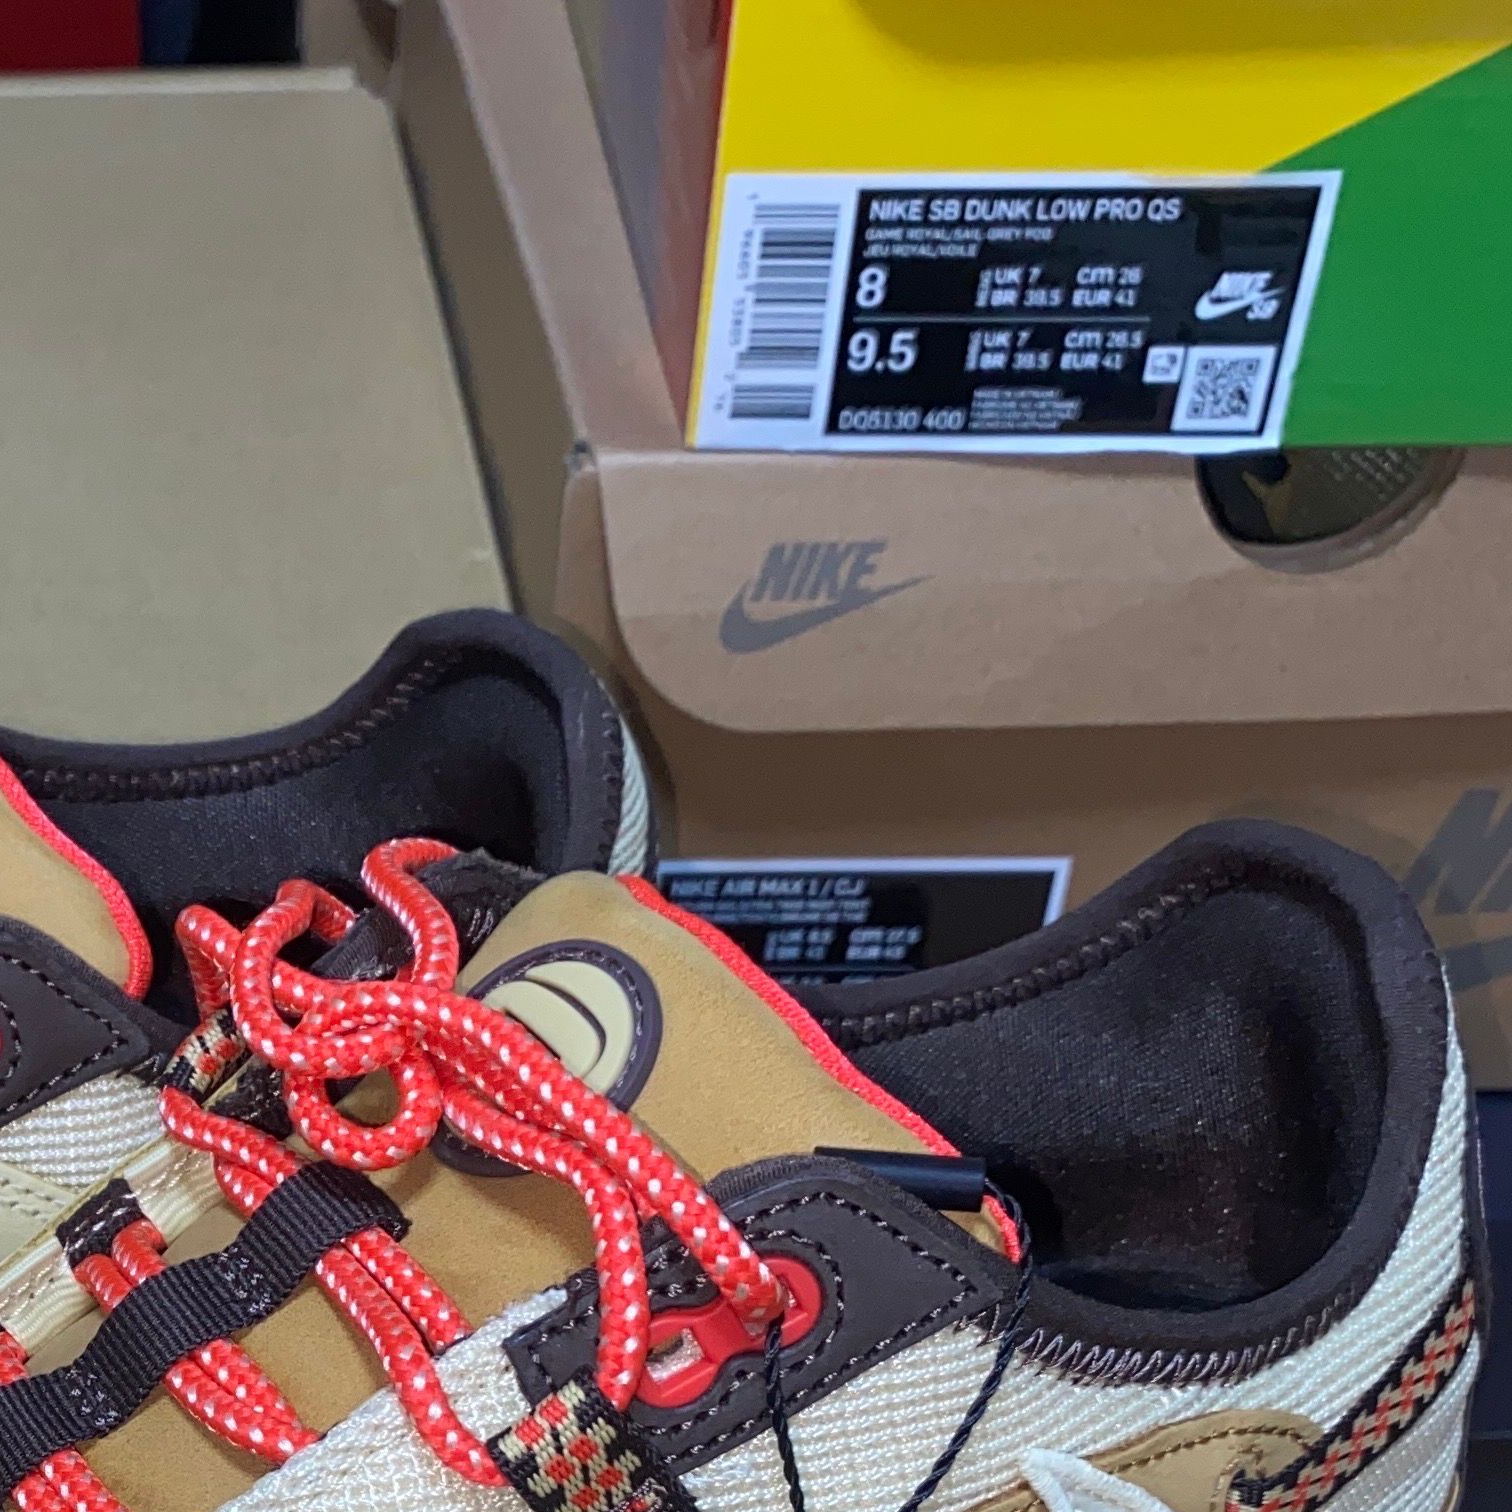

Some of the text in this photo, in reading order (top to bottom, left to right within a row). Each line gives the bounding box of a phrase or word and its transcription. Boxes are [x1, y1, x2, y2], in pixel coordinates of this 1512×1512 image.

[869, 197, 1183, 223] NIKE SB DUNK LOW PRO QS
[993, 267, 1043, 285] UK 7
[1117, 266, 1144, 286] 26
[855, 265, 887, 309] 8
[990, 288, 1019, 307] BR
[1071, 288, 1137, 307] EUR 41
[982, 330, 1035, 348] UK 7
[846, 327, 920, 373] 9.5
[978, 352, 1007, 371] BR
[1059, 352, 1125, 371] EUR 41
[749, 540, 887, 602] NIKE
[669, 878, 721, 897] NIKE
[721, 878, 758, 897] AIR
[758, 878, 806, 897] MAX
[833, 877, 866, 897] CJ
